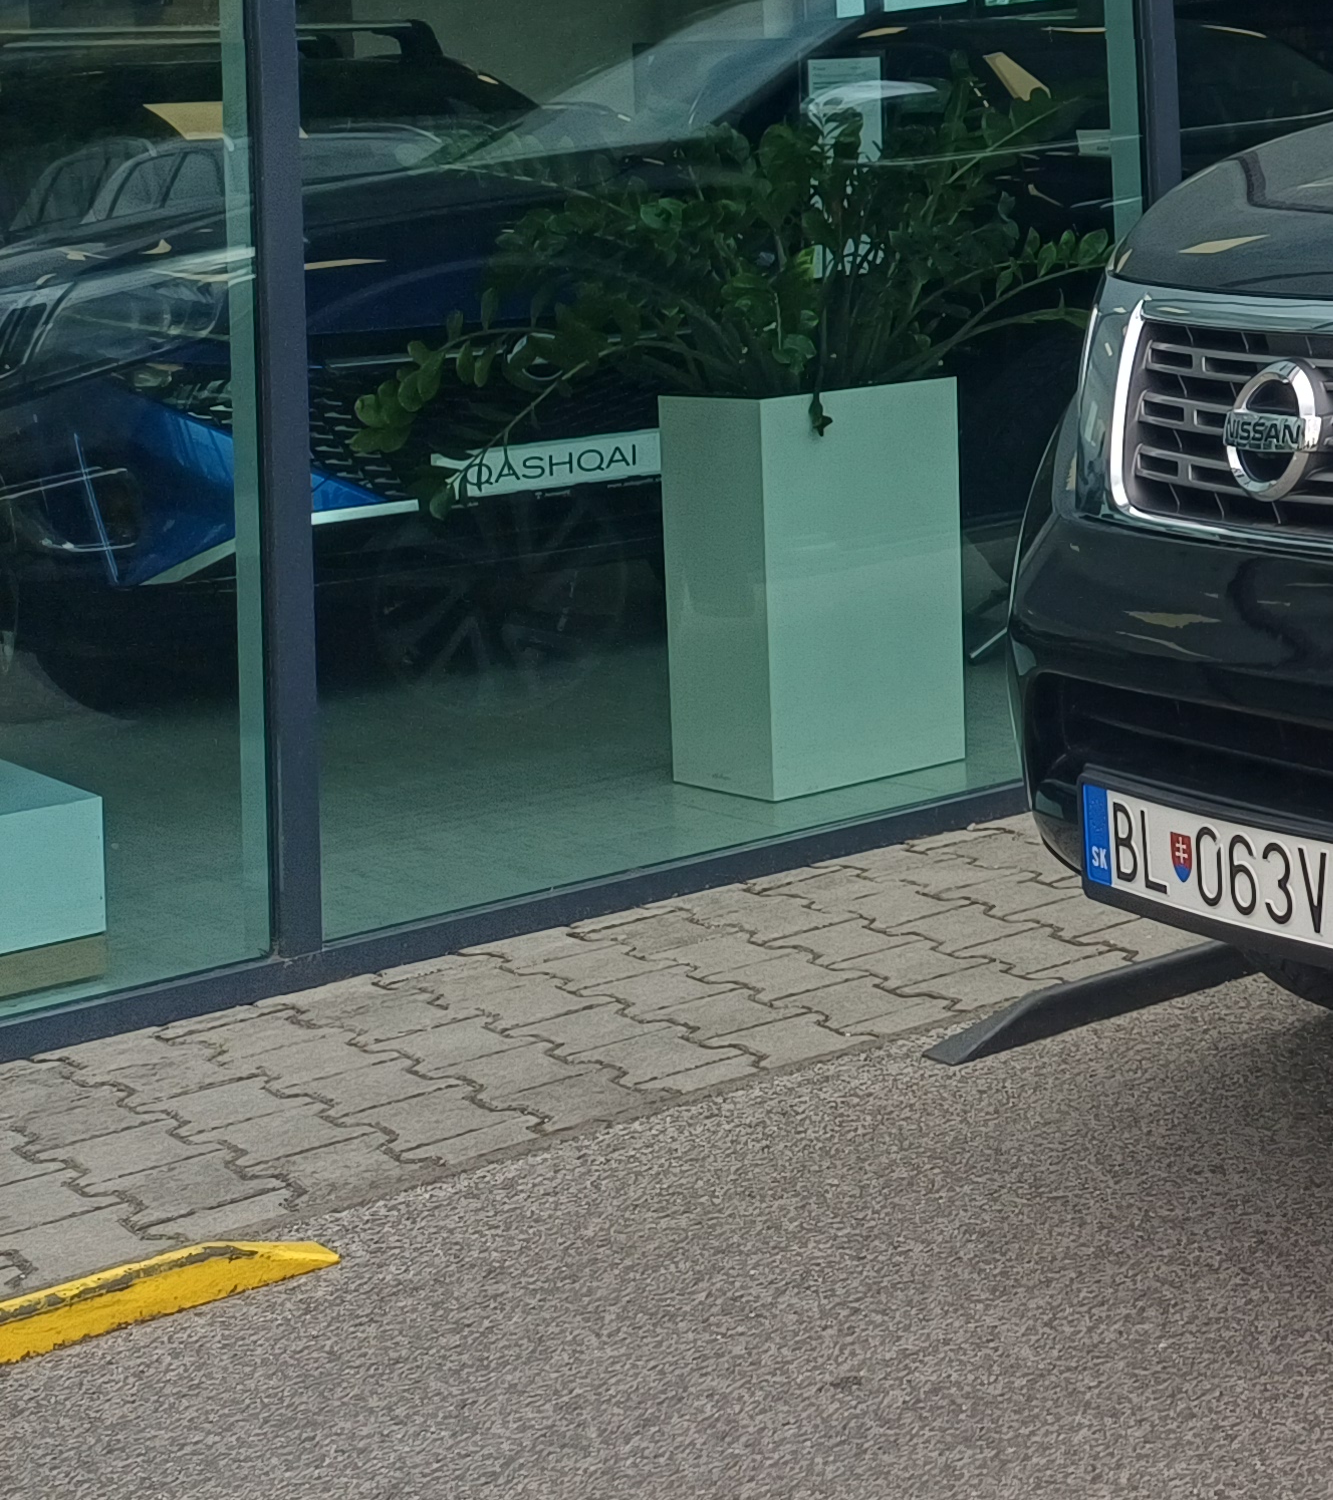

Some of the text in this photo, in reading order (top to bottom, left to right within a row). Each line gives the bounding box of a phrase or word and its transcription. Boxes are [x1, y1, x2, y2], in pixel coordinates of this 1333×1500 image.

[1225, 419, 1302, 445] NISSAN
[464, 444, 637, 486] QASHQAI
[1091, 845, 1108, 870] SK
[1112, 802, 1167, 895] BL
